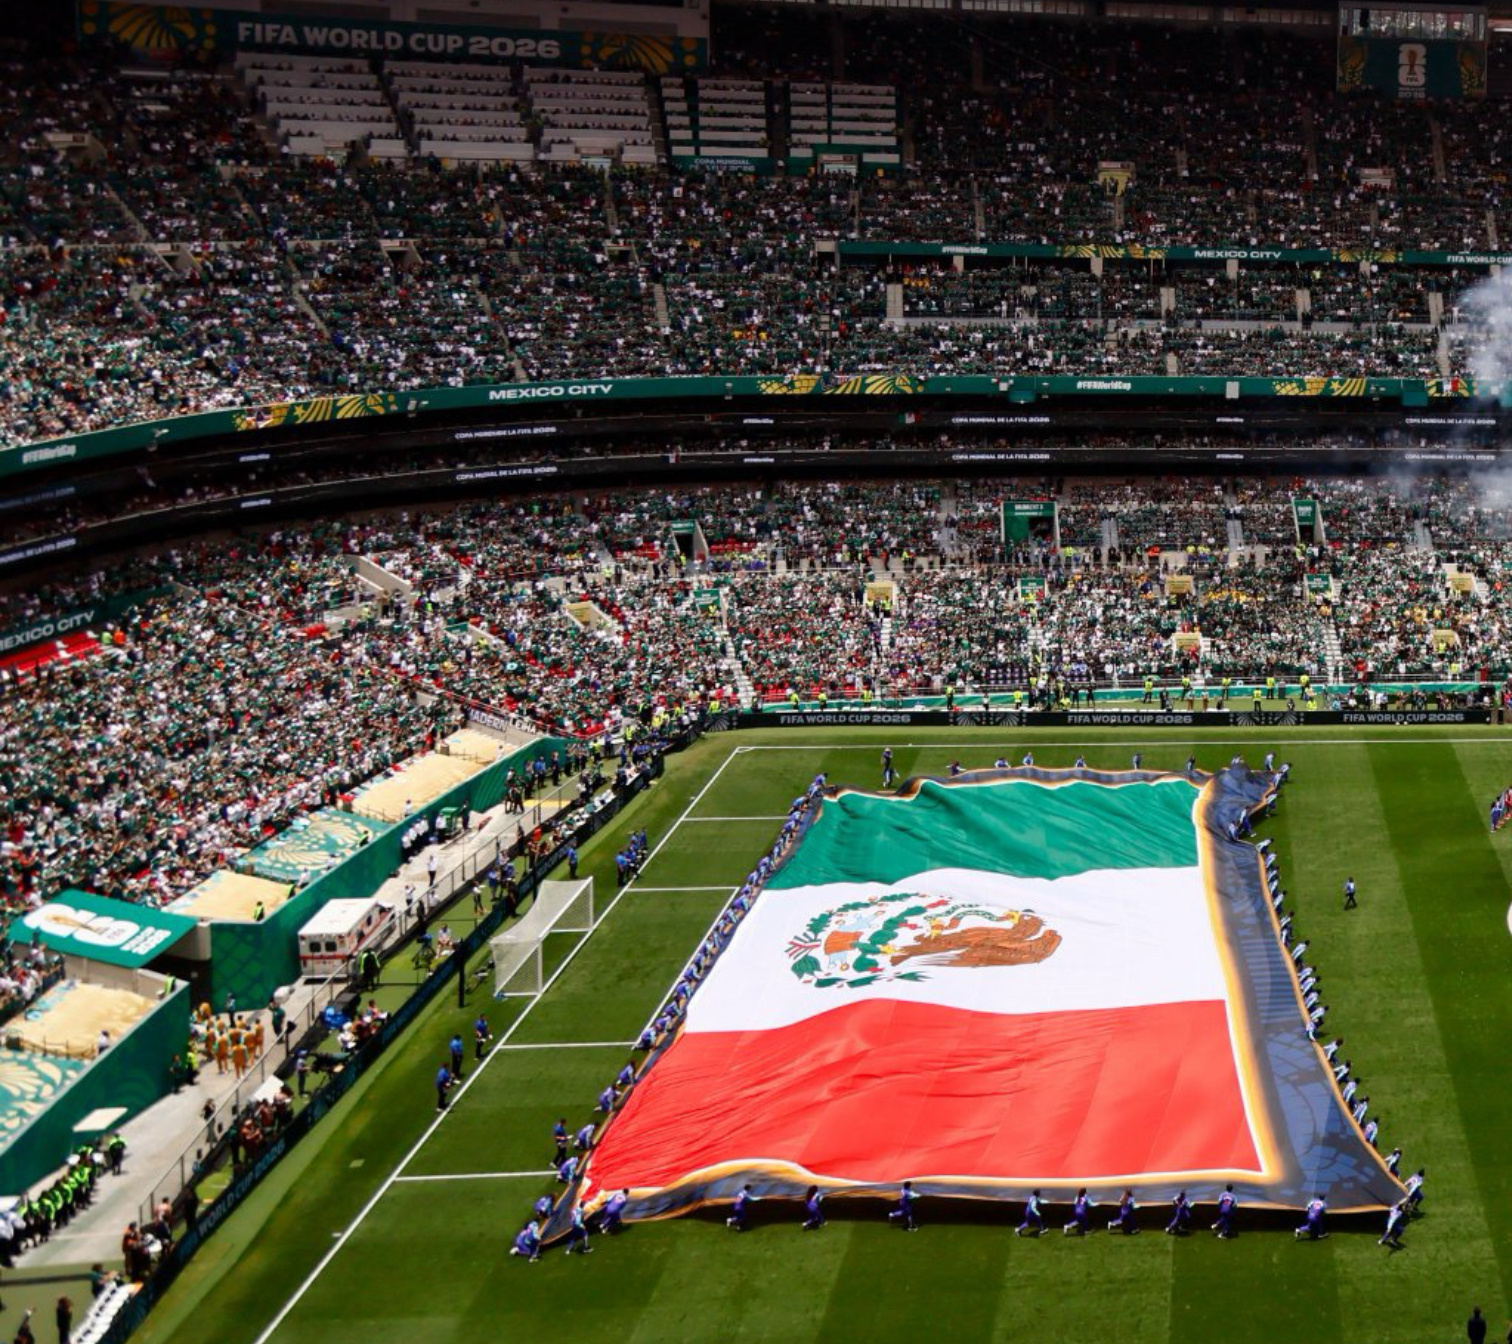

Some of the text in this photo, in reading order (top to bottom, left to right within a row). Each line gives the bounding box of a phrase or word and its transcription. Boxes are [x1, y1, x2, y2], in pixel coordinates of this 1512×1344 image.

[237, 21, 562, 59] FIFA WORLD CUP 2026
[1194, 250, 1282, 259] MEXICO CITY
[1446, 255, 1465, 263] FIFA
[1465, 255, 1496, 263] WORLD
[489, 384, 614, 401] MEXICO CITY
[57, 611, 96, 635] CITY
[780, 715, 911, 724] FIFA WORLD CUP 2026
[1067, 715, 1193, 724] FIFA WORLD CUP 2026
[1343, 714, 1465, 723] FIFA WORLD CUP 2026
